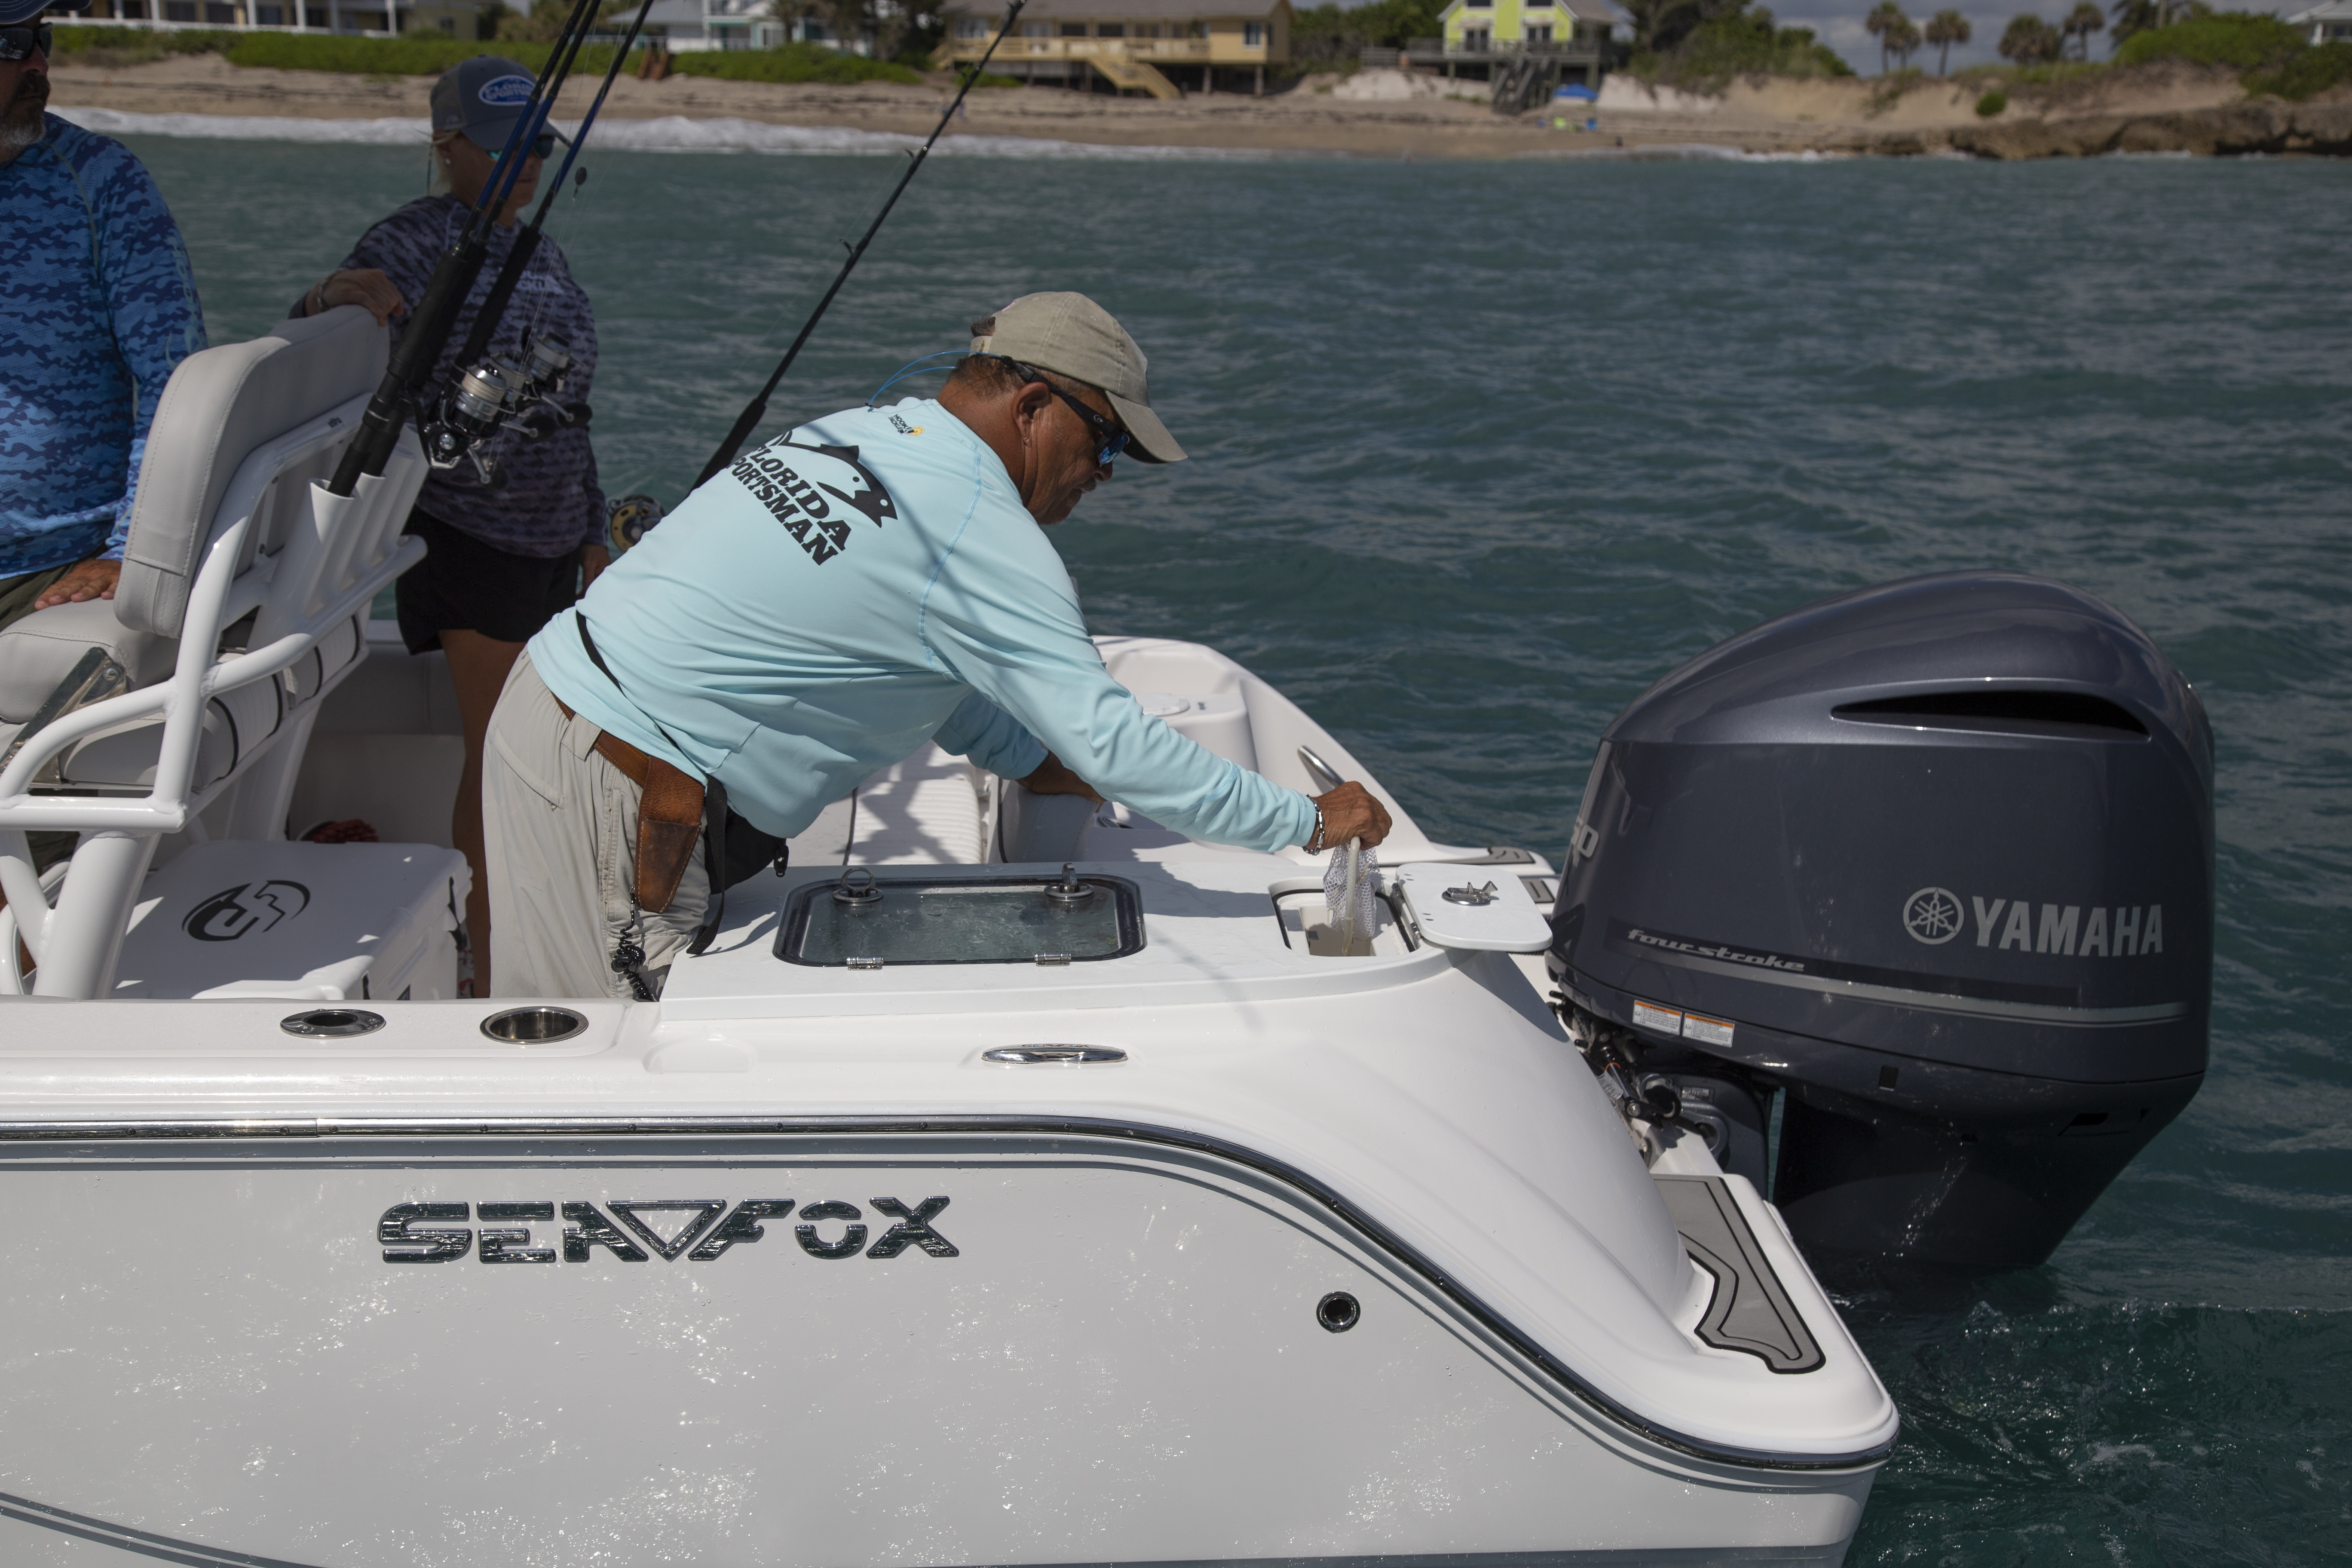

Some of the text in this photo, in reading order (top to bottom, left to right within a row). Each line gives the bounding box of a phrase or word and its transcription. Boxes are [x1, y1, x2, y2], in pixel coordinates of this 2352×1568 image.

[893, 414, 909, 429] HOOK
[726, 456, 839, 566] PORTSMAN
[1972, 895, 2163, 957] YAMAHA
